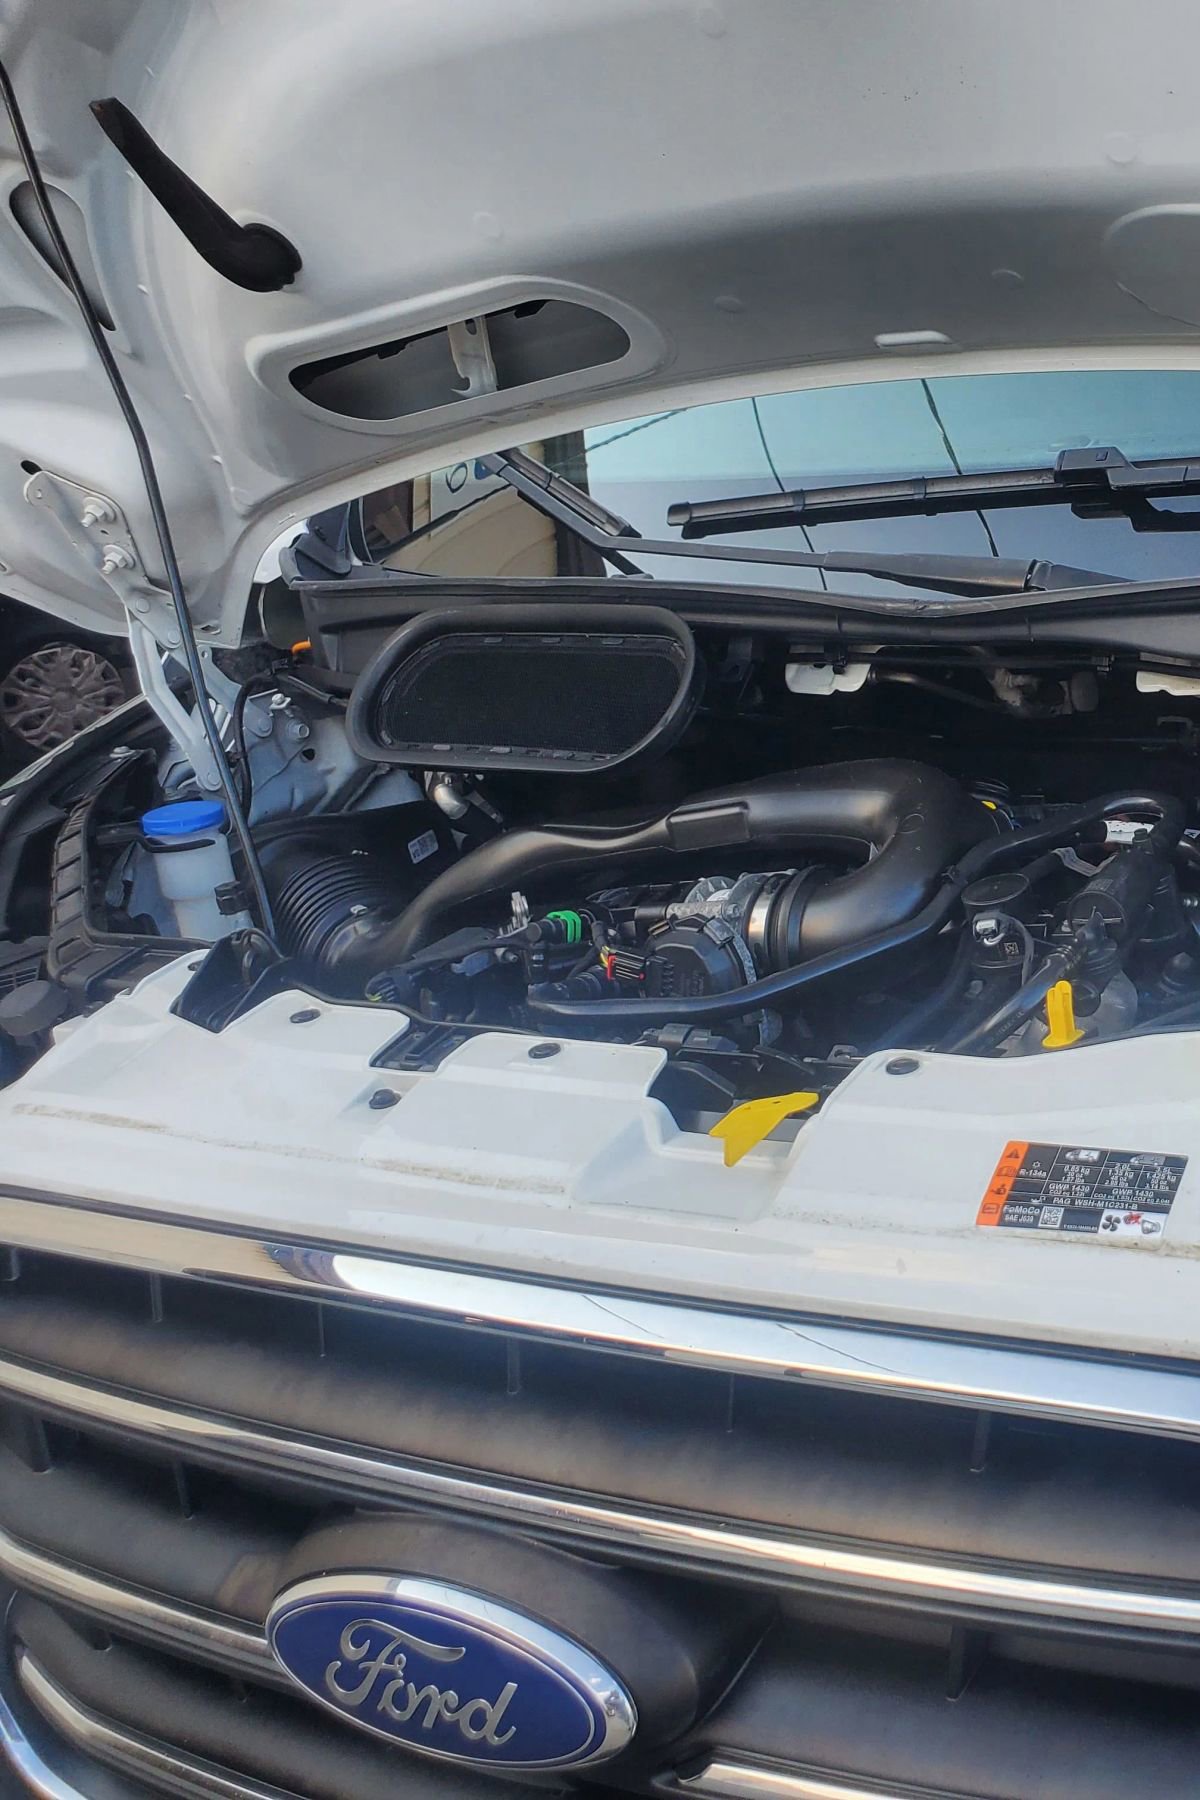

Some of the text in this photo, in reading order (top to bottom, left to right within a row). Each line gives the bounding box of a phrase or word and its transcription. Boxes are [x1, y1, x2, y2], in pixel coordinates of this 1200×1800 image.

[1019, 1168, 1047, 1177] R-134a
[1135, 1190, 1154, 1198] 1430
[1053, 1197, 1138, 1209] PAG WSH-M1C231-B
[1003, 1205, 1040, 1214] FoMoCo
[324, 1618, 519, 1745] Ford
